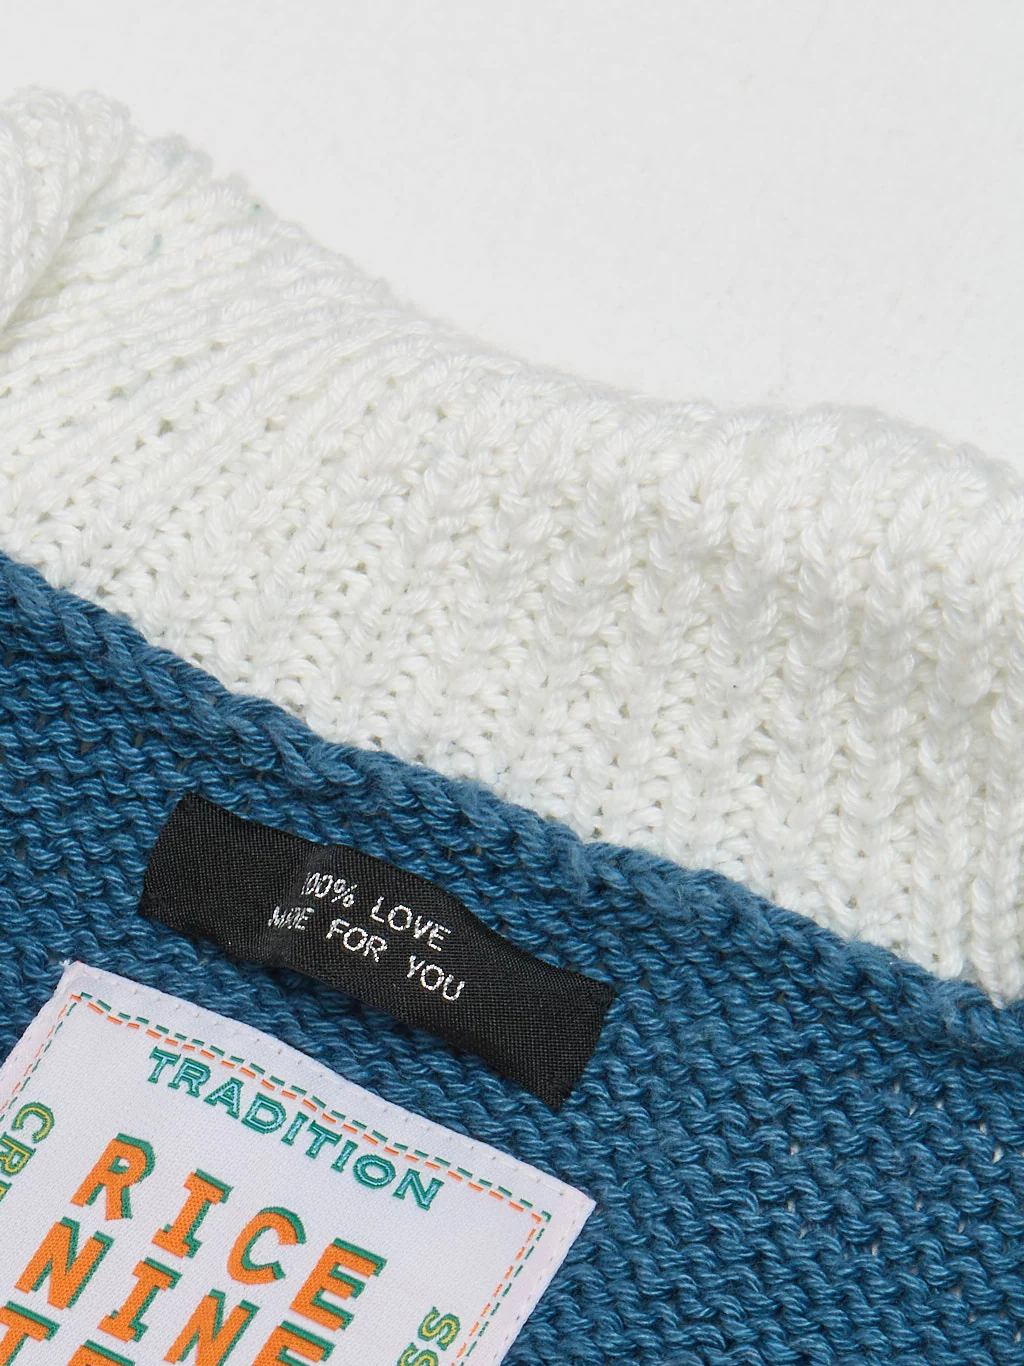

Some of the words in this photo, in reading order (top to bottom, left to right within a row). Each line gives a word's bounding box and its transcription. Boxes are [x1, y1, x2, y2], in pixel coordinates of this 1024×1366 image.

[300, 872, 358, 908] 100%
[370, 896, 452, 951] LOVE
[326, 918, 388, 963] FOR
[407, 954, 466, 1001] YOU
[148, 1046, 445, 1211] TRADITION
[70, 1133, 387, 1332] RICE
